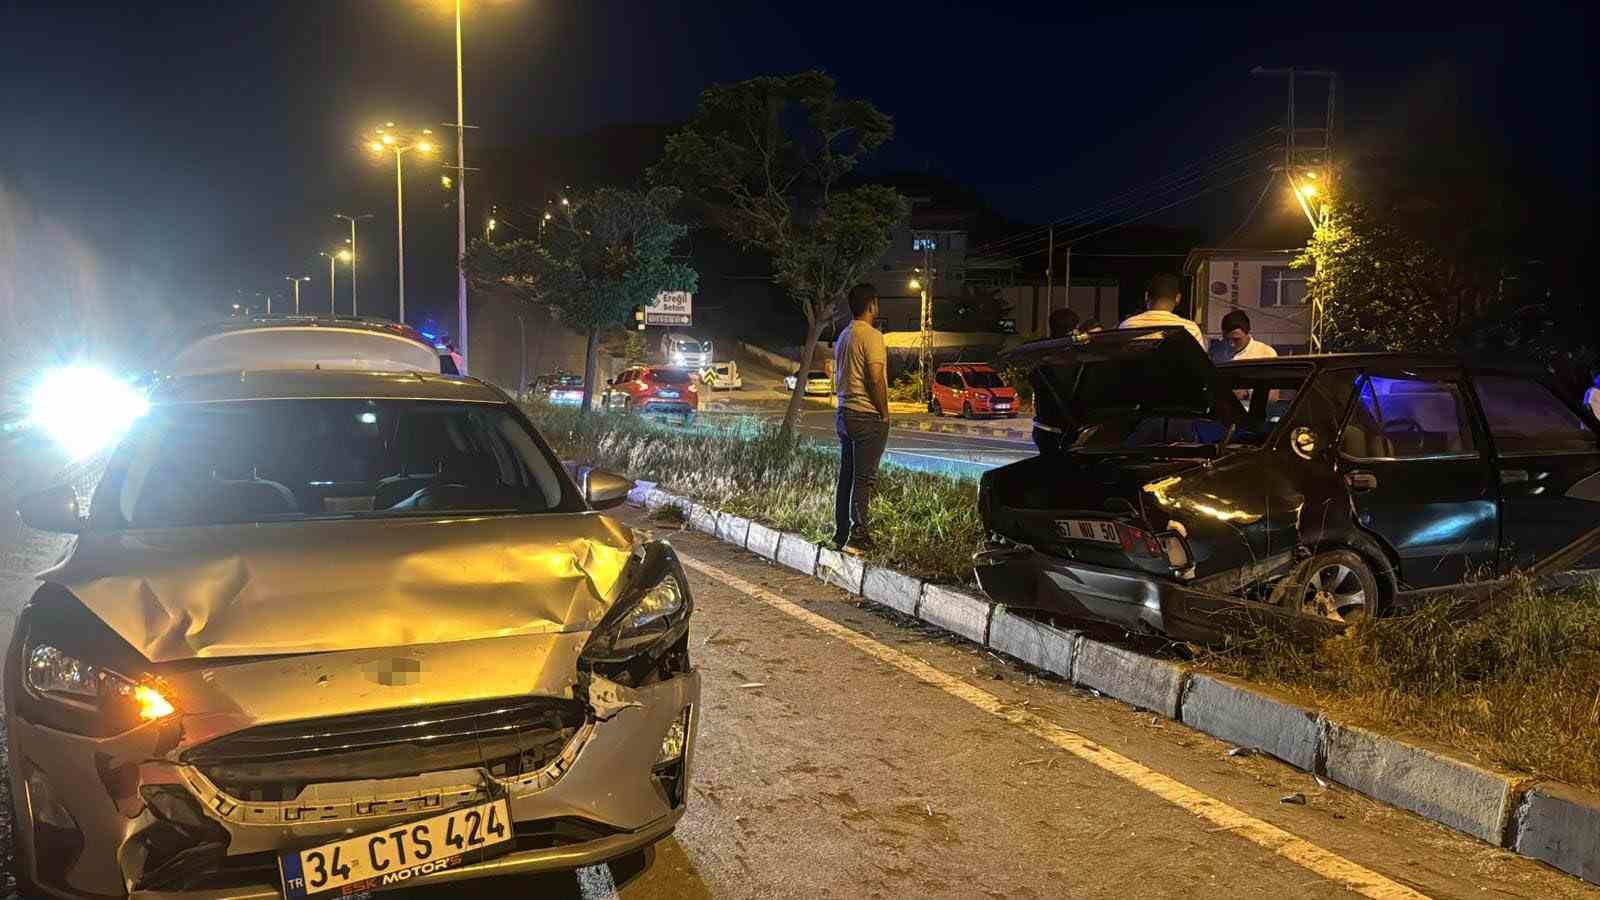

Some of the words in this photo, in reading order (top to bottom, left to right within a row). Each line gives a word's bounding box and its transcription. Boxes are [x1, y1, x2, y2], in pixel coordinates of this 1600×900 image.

[1100, 523, 1116, 540] 50
[306, 846, 351, 888] 34
[368, 824, 432, 871] CTS
[445, 805, 505, 849] 424
[288, 877, 304, 890] TR
